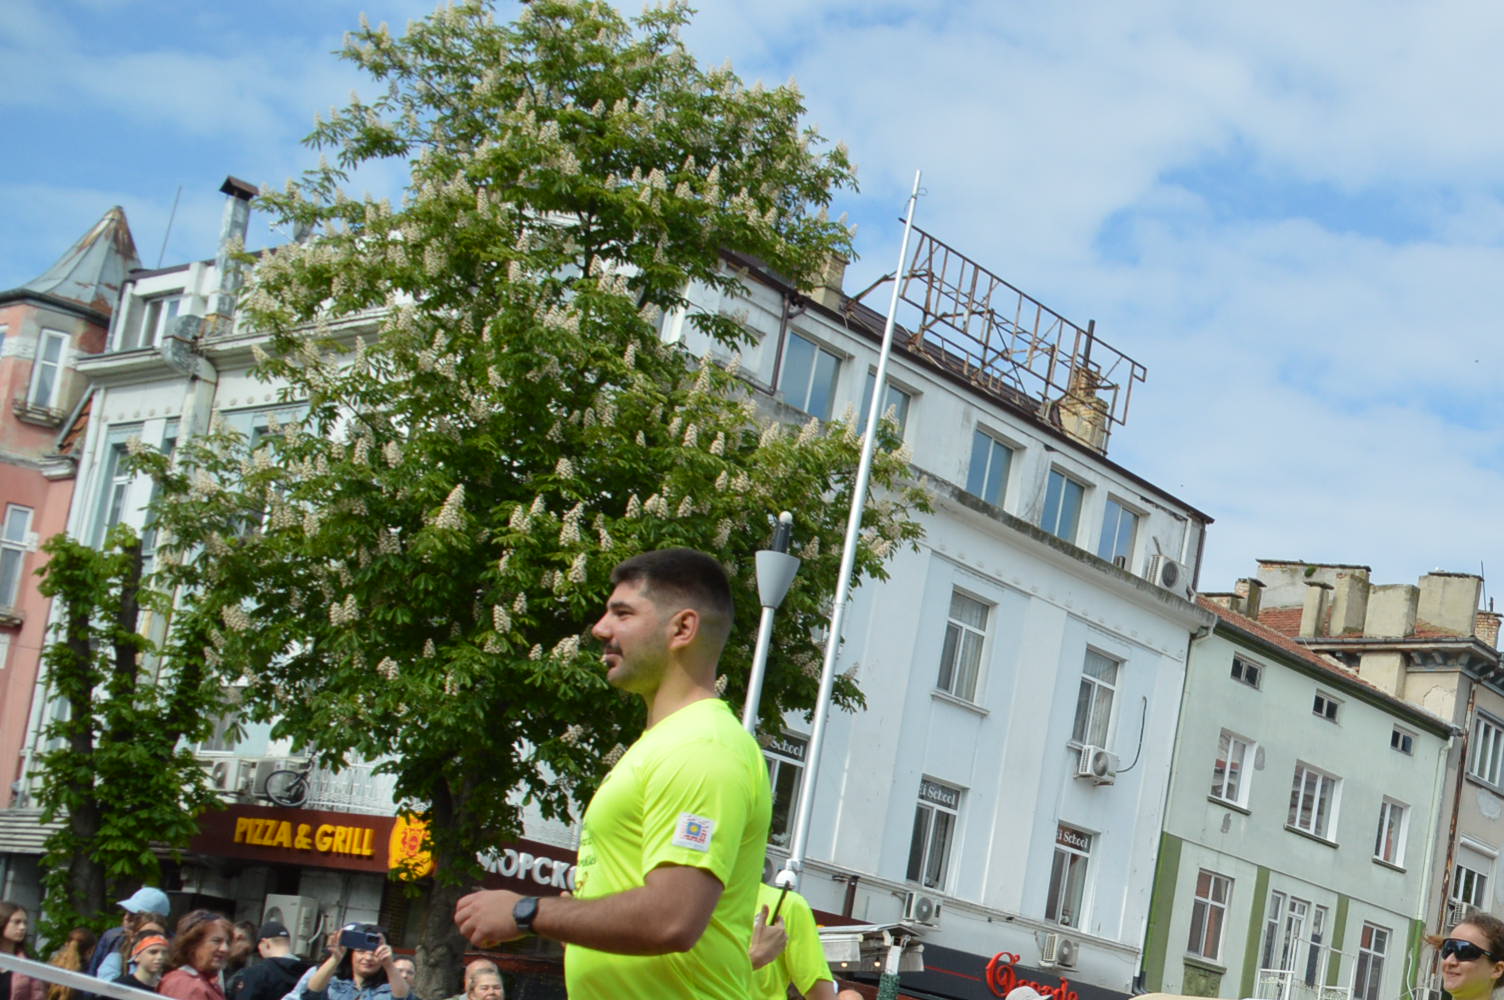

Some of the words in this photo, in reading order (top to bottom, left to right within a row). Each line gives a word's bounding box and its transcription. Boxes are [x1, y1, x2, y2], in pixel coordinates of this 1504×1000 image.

[234, 817, 294, 848] PIZZA
[294, 824, 312, 850] &
[315, 823, 375, 857] GRILL
